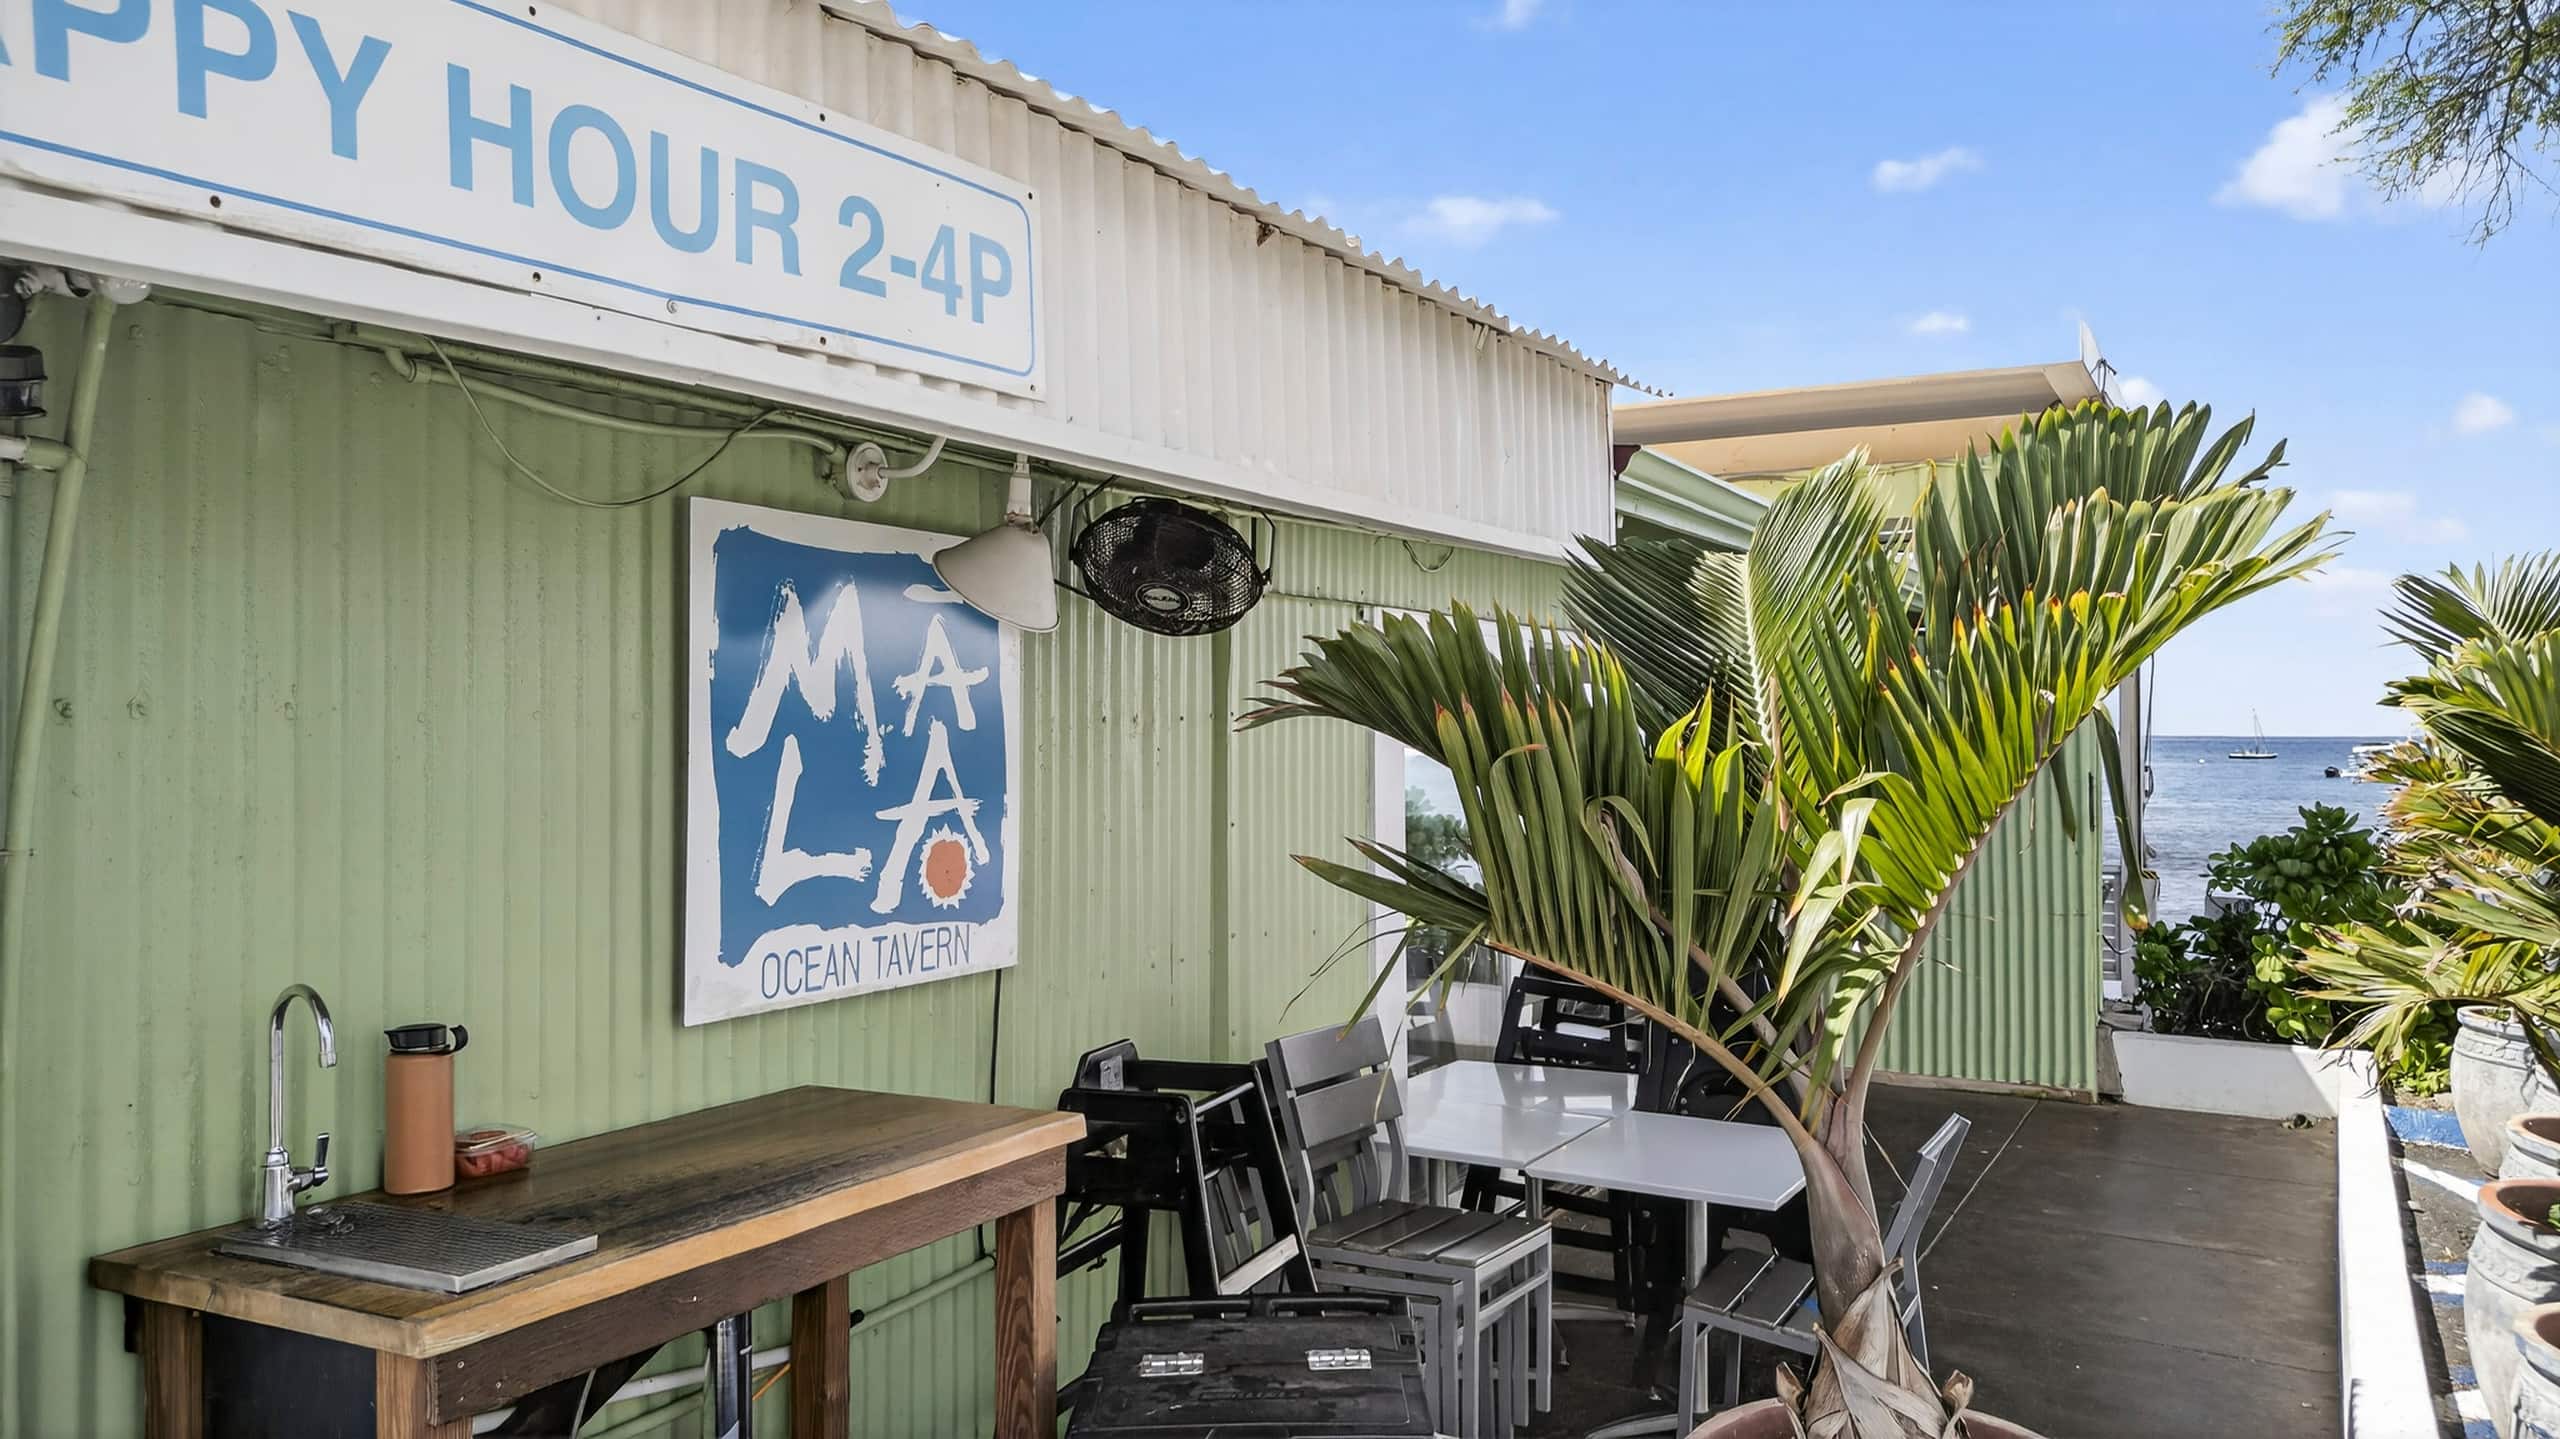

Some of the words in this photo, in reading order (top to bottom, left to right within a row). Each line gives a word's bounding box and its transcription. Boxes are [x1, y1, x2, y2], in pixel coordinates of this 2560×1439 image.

[0, 0, 393, 160] PPY
[447, 62, 802, 277] HOUR
[838, 194, 1013, 324] 2-4P
[760, 941, 862, 1000] OCEAN
[872, 924, 971, 982] TAVERN
